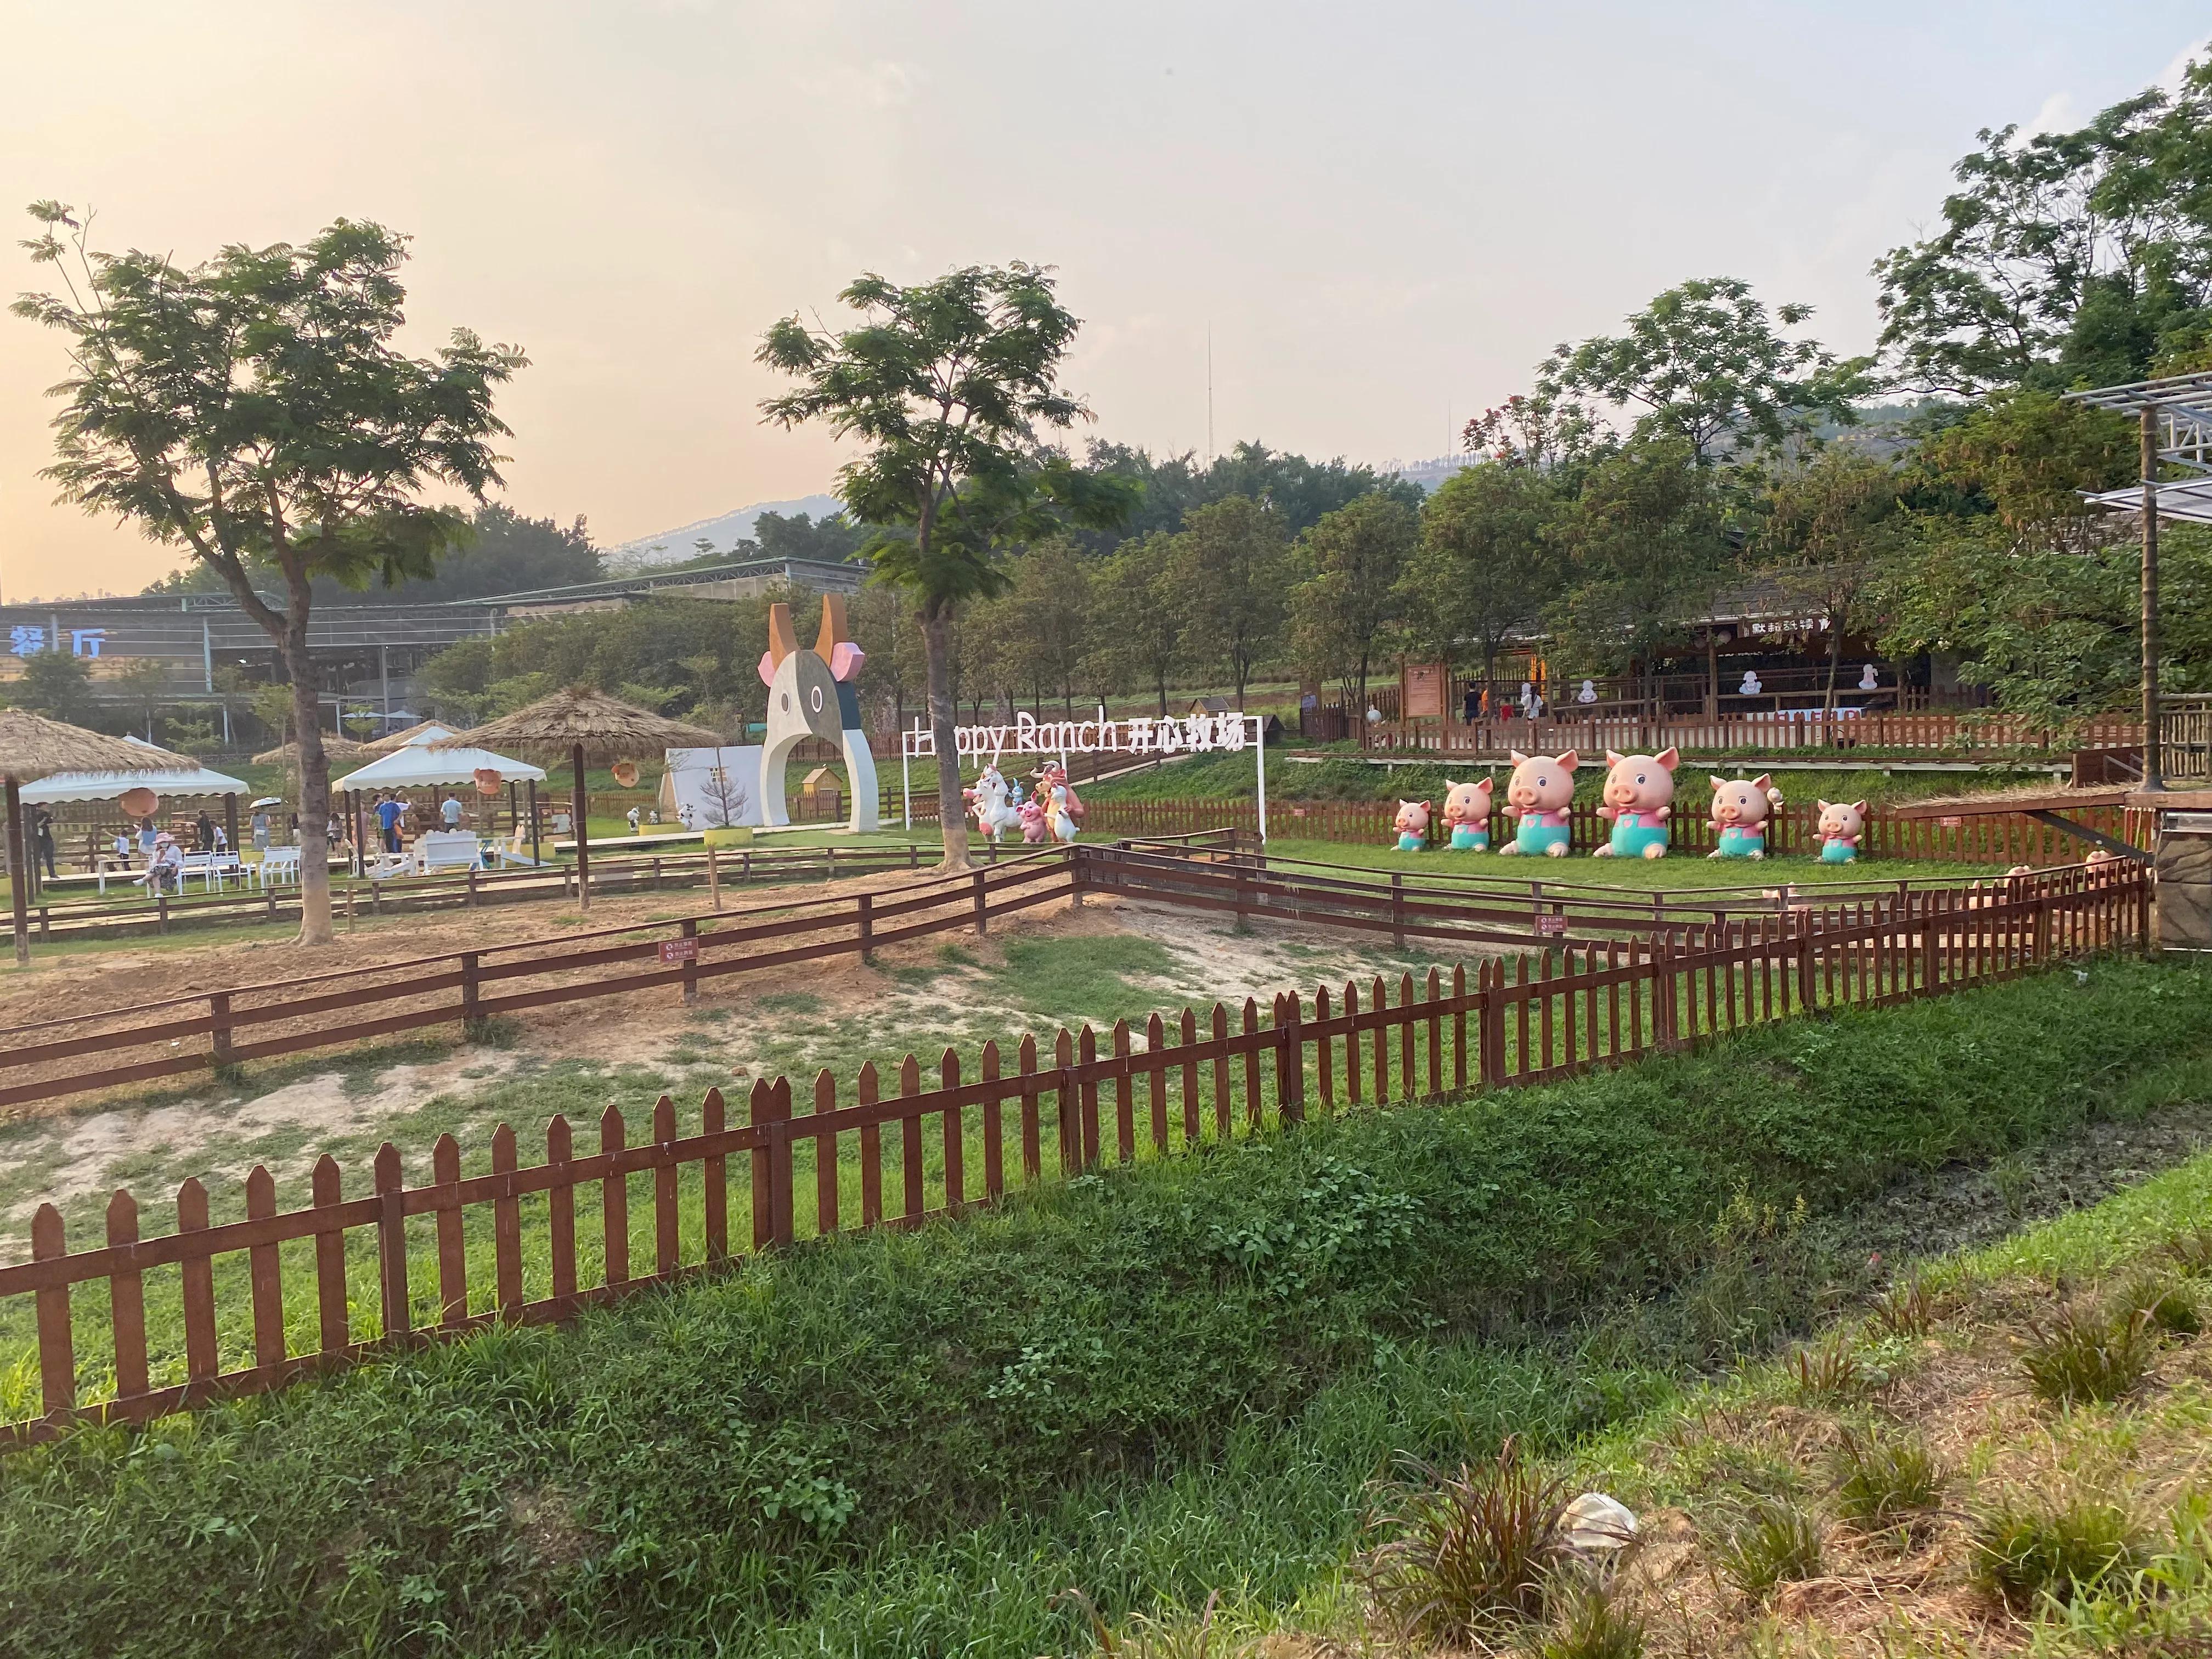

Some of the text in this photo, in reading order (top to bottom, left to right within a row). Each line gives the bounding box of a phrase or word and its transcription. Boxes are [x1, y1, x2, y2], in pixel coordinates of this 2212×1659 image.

[10, 625, 106, 658] 餐厅
[915, 705, 1245, 769] Hppy Ranch 开心牧场
